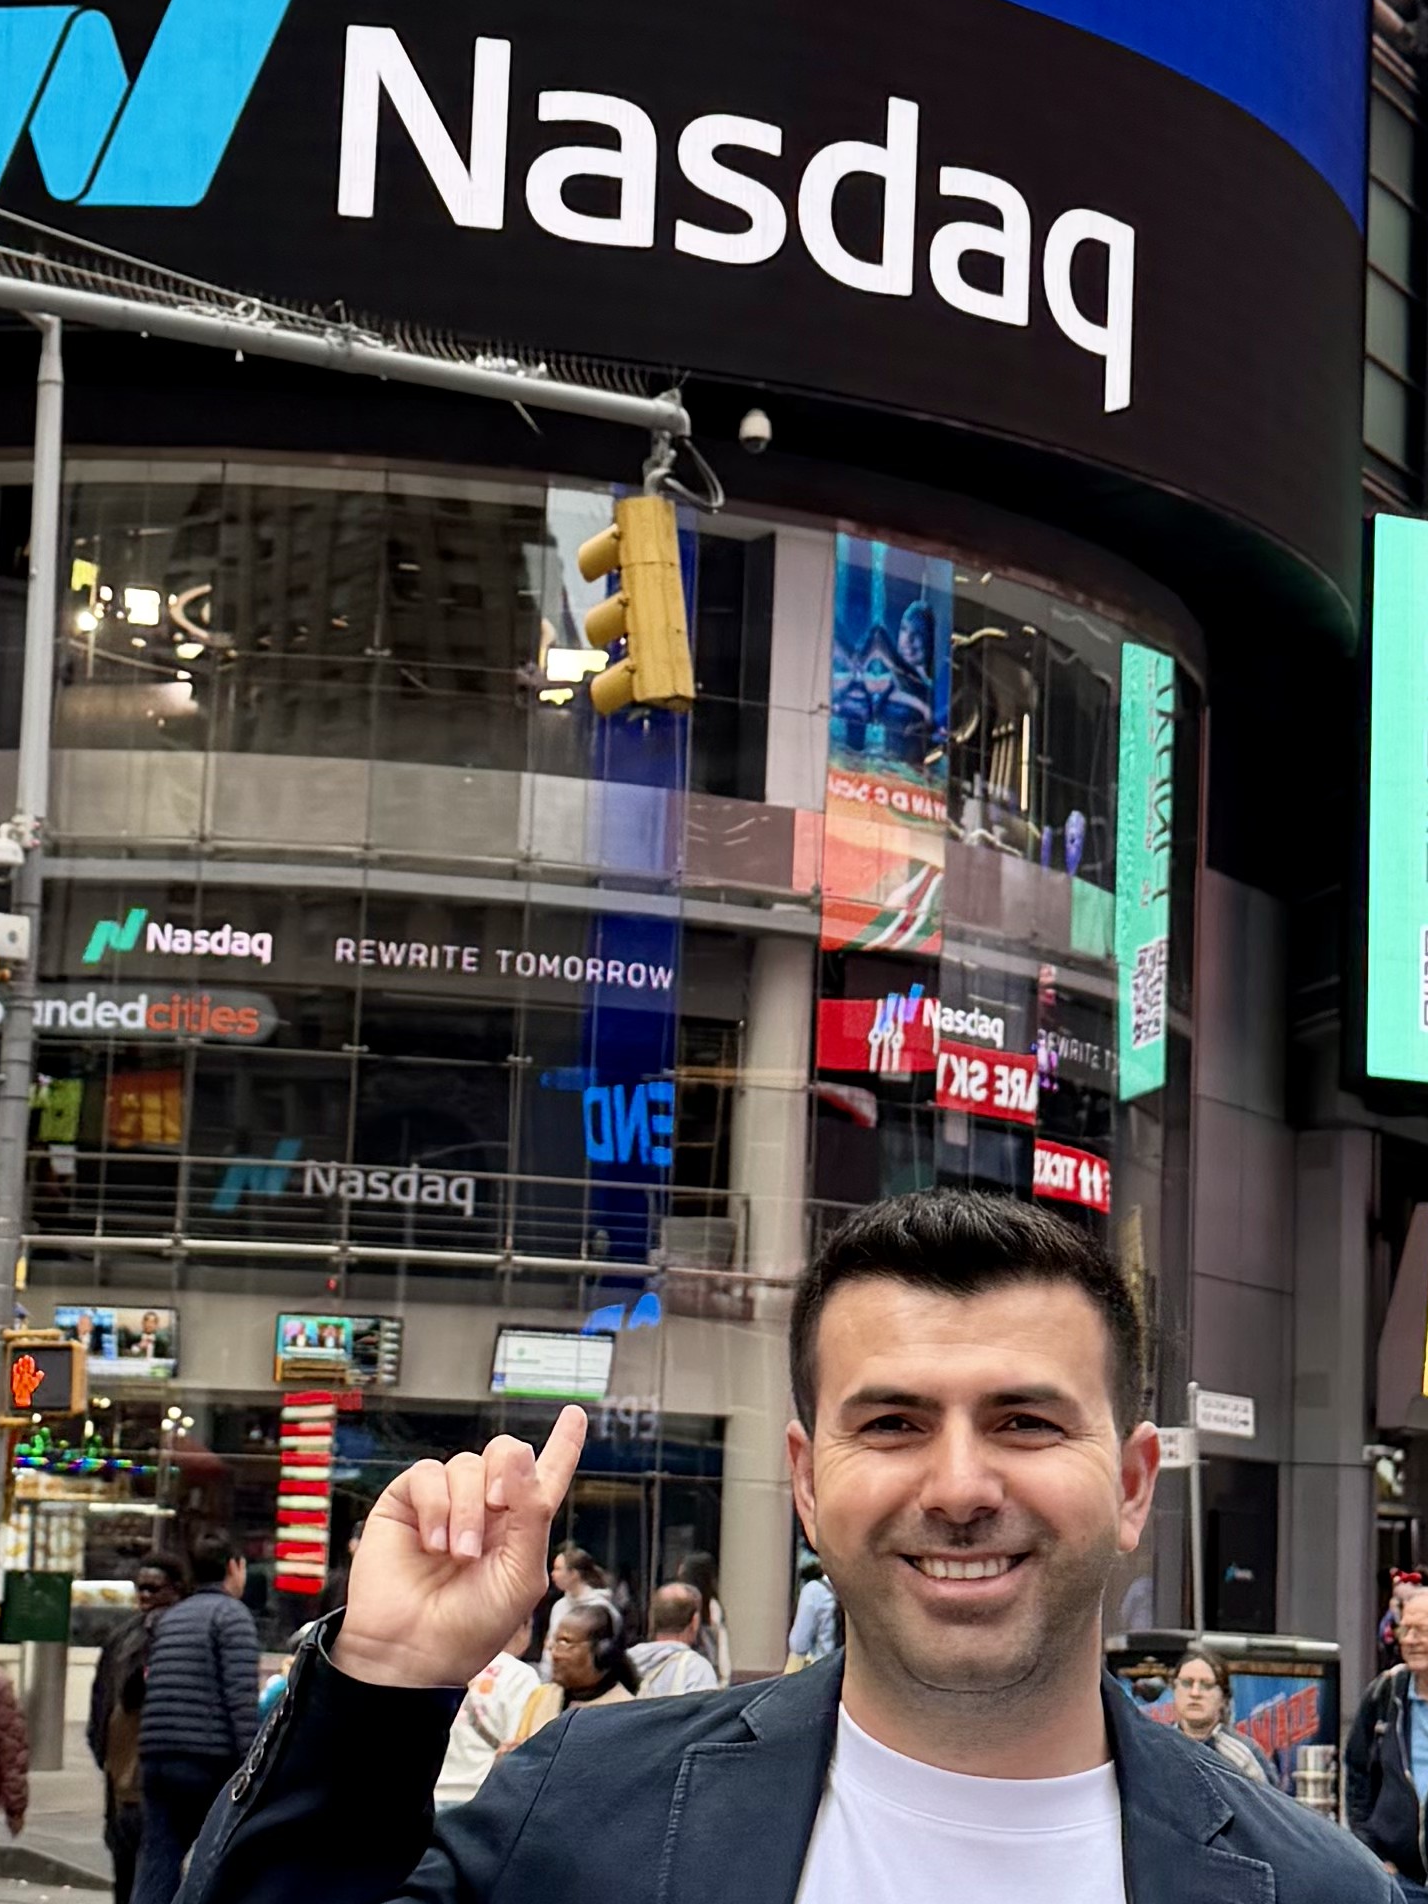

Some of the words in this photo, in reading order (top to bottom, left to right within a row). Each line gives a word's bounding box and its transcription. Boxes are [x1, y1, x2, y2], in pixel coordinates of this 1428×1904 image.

[337, 23, 1137, 414] Nasdaq
[146, 921, 274, 965] Nasdaq
[335, 937, 481, 973] REWRITE
[494, 948, 675, 992] TOMORROW
[923, 998, 1006, 1049] Nasdaq
[304, 1160, 476, 1218] Nasdaq
